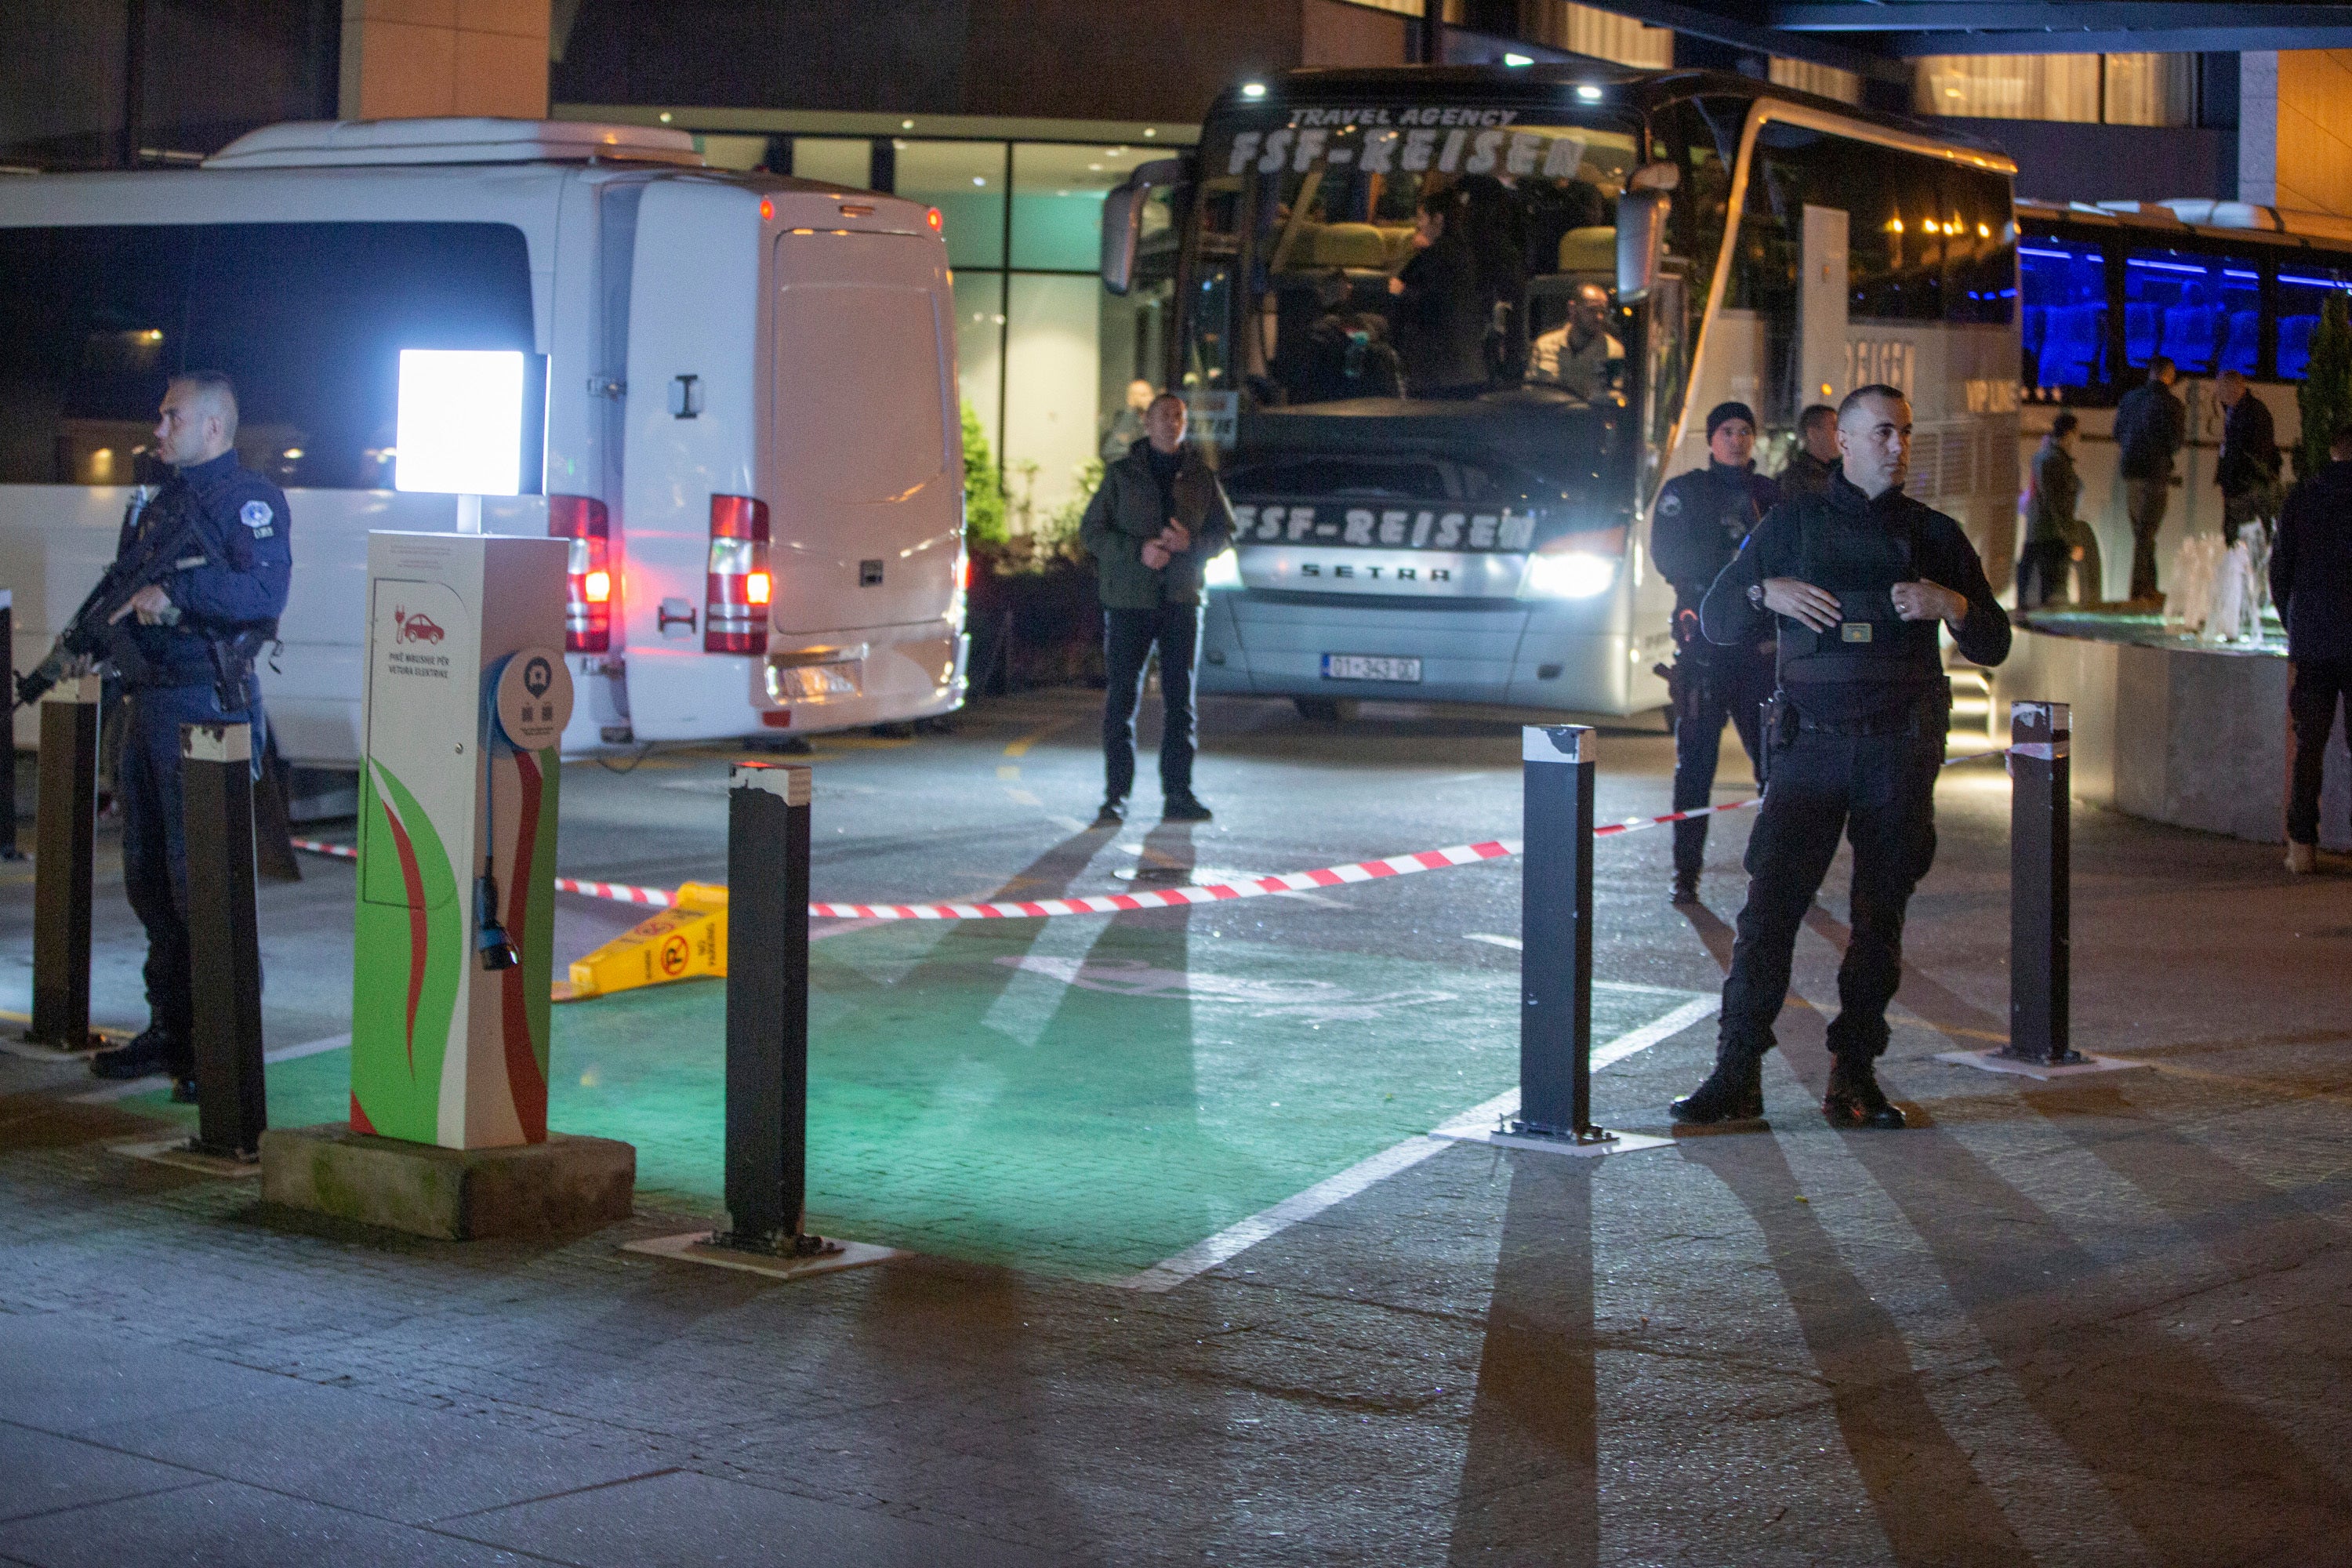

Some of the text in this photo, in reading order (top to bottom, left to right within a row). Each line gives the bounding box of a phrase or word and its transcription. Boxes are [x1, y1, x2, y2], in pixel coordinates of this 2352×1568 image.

[1287, 109, 1518, 128] TRAVEL AGENCY
[1229, 129, 1585, 178] FSF-REISEN
[1235, 506, 1537, 550] FSF-REISEN
[1301, 563, 1452, 583] SETRA
